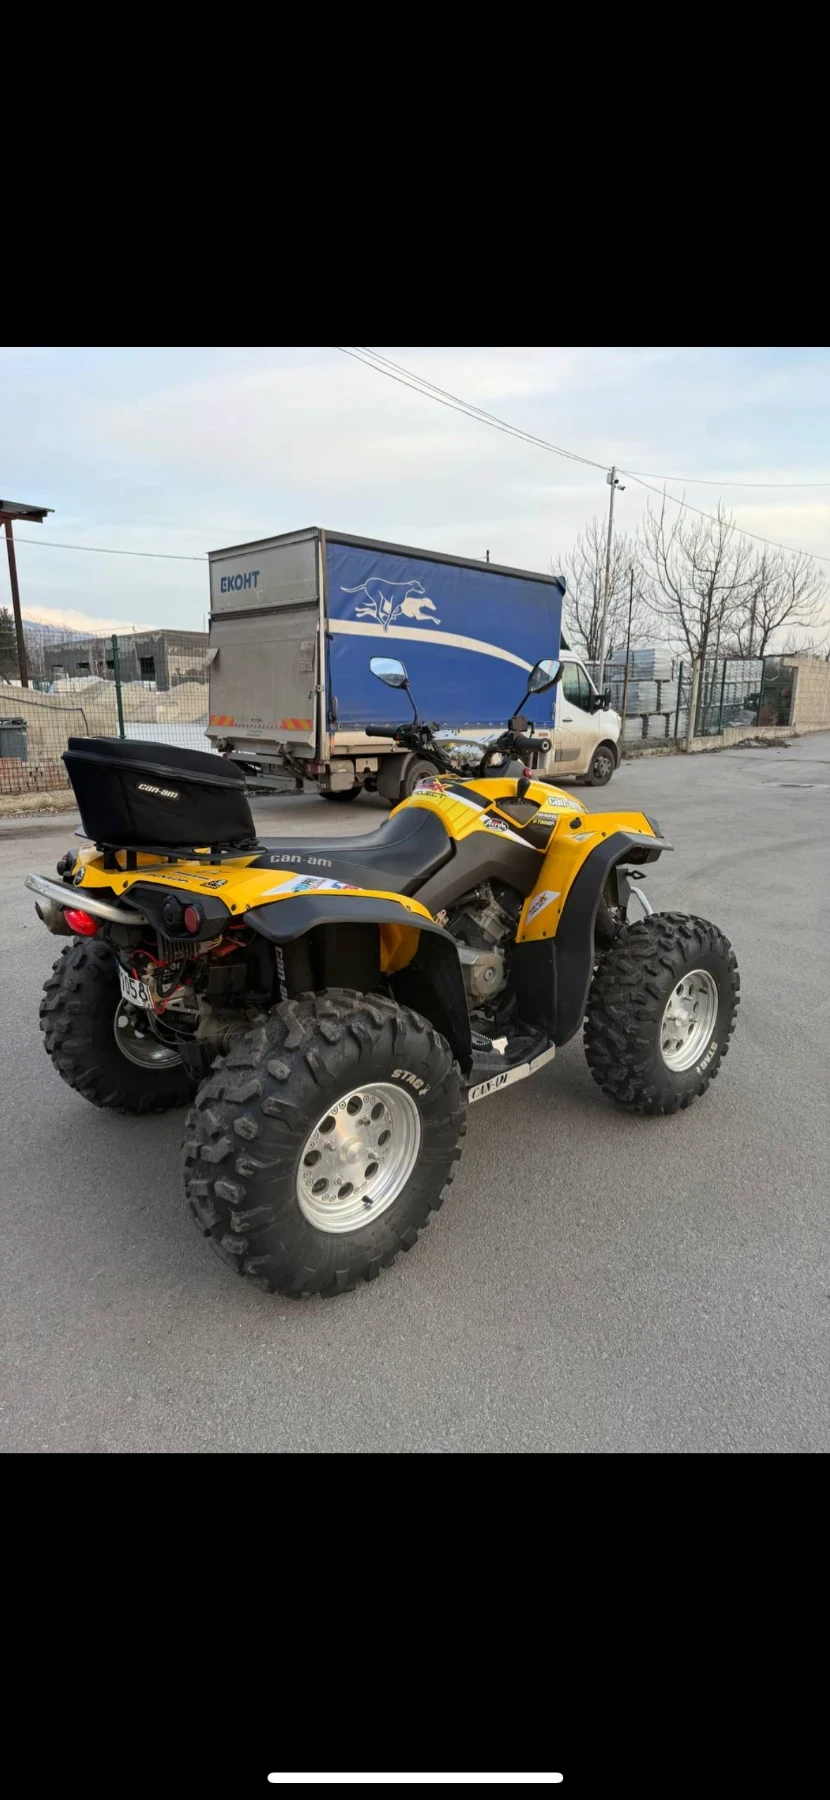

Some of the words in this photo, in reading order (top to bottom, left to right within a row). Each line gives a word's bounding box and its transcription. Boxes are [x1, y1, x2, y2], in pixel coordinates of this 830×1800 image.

[138, 783, 178, 799] can-am
[270, 854, 332, 868] can-am
[391, 1069, 424, 1090] STAG
